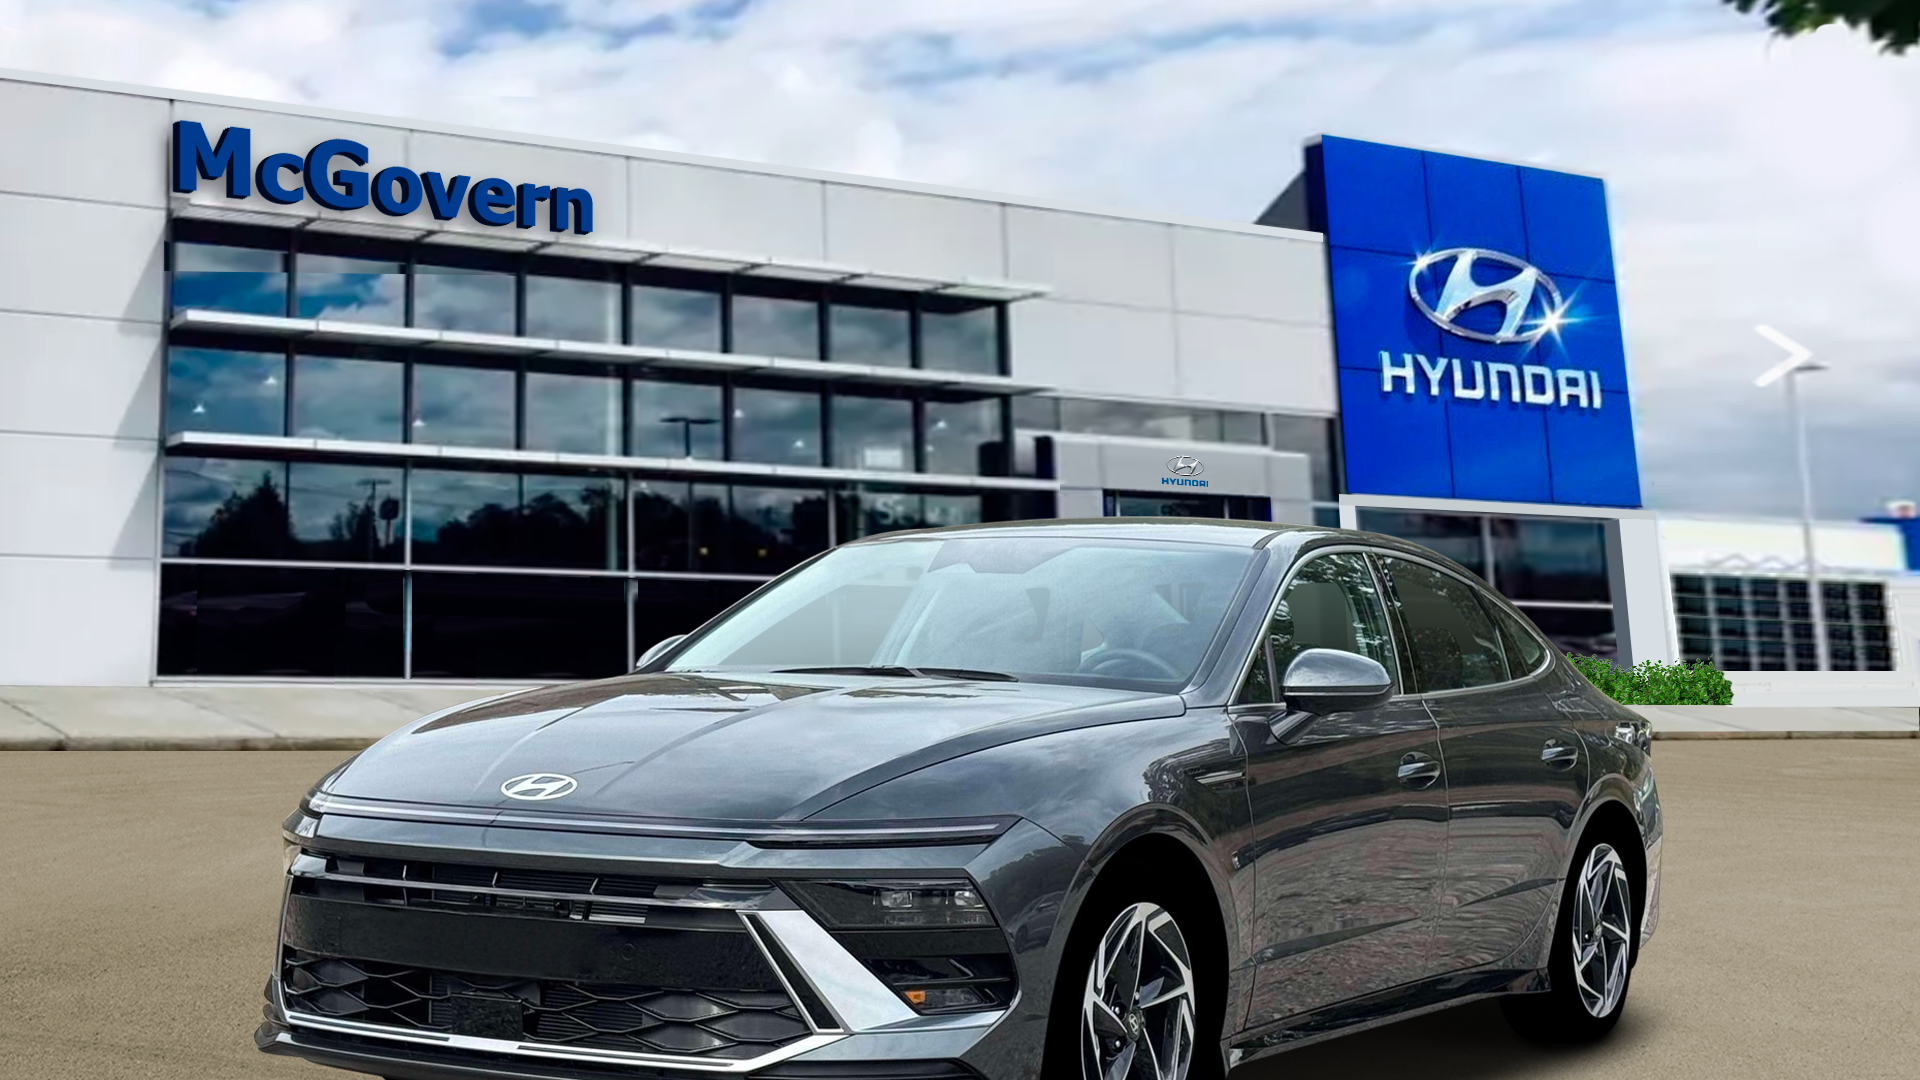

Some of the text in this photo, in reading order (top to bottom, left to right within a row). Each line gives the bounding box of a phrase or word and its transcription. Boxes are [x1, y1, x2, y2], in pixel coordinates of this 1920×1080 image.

[172, 119, 594, 236] McGovern
[1379, 350, 1602, 410] HYUNDAI
[1161, 477, 1209, 488] HYUNDAI
